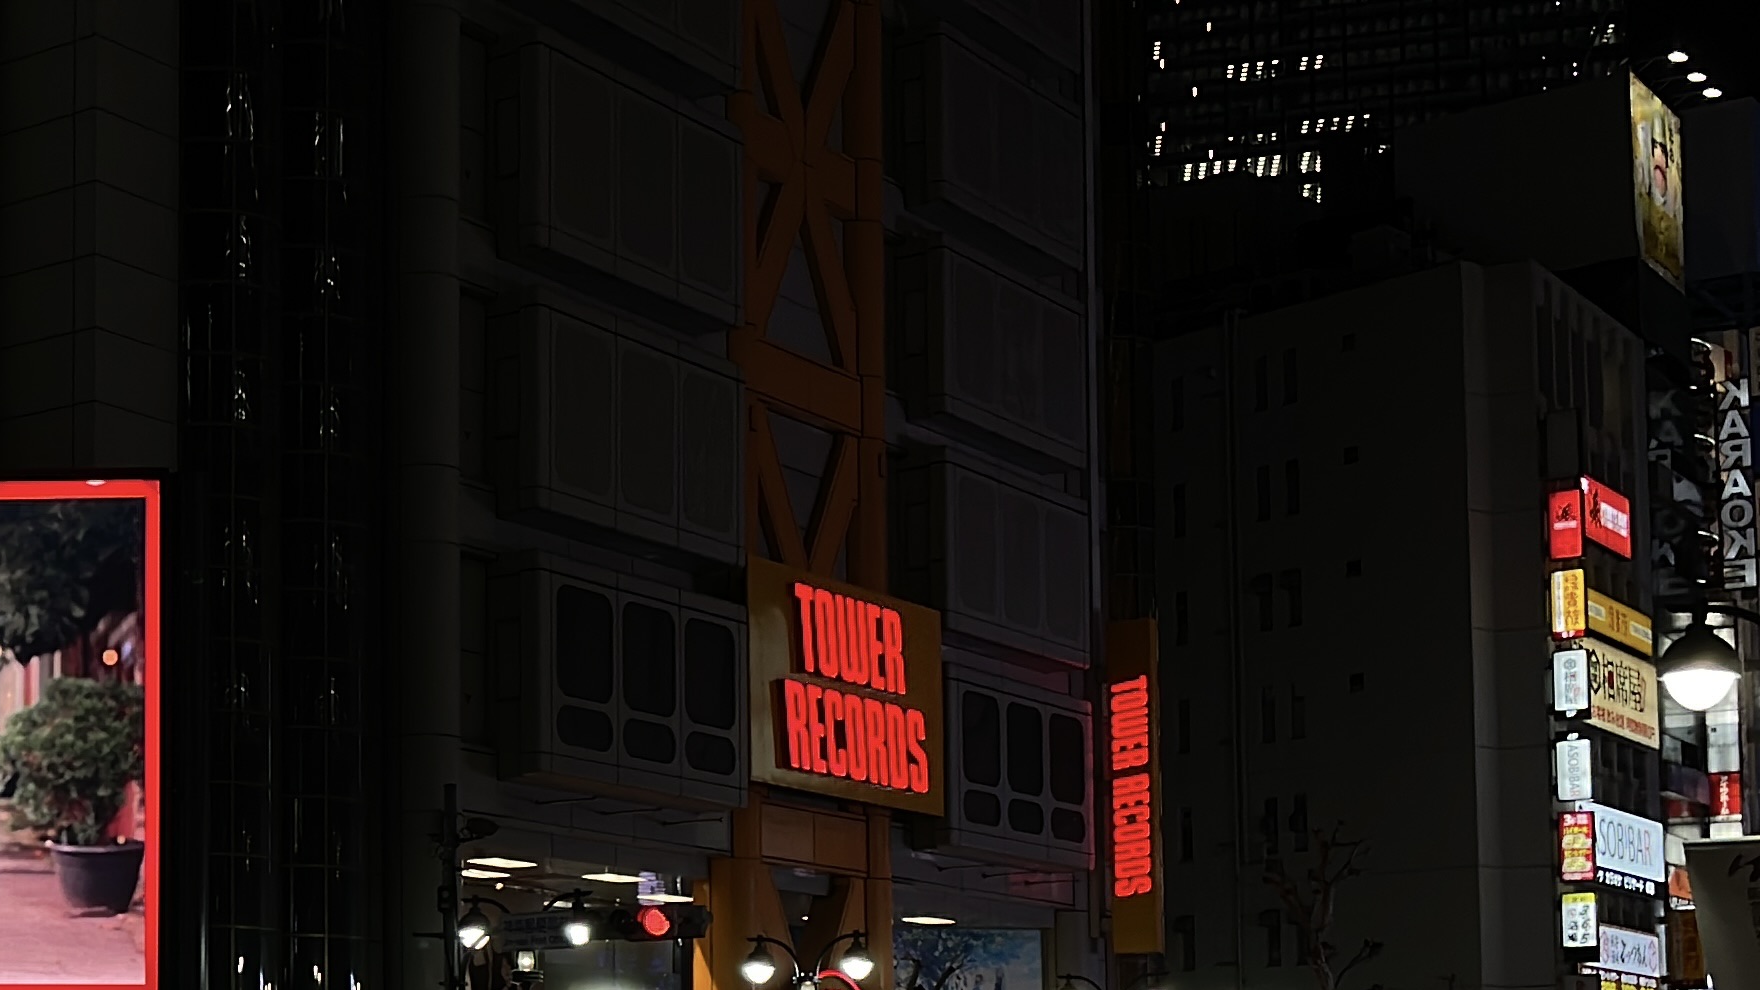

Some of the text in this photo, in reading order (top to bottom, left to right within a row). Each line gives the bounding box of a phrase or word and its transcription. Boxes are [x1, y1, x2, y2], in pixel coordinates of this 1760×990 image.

[794, 582, 906, 695] TOWER
[784, 678, 929, 794] RECORDS
[1111, 675, 1152, 897] TOWER RECORDS
[1598, 818, 1652, 866] SOBIBAR
